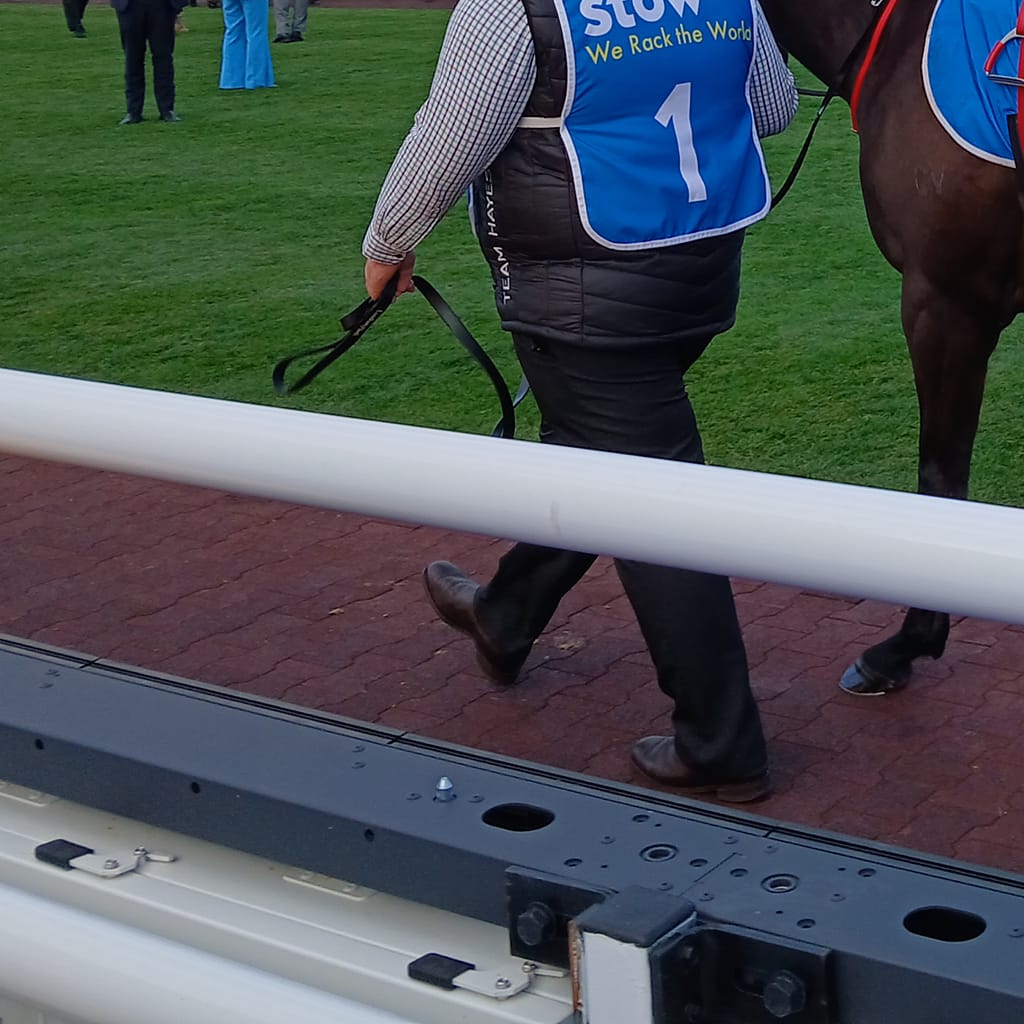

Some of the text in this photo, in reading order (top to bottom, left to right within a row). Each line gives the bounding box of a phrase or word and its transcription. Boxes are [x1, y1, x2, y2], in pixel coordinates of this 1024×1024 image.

[585, 19, 752, 65] We Rack the World
[653, 81, 708, 204] 1
[493, 246, 511, 305] TEAM
